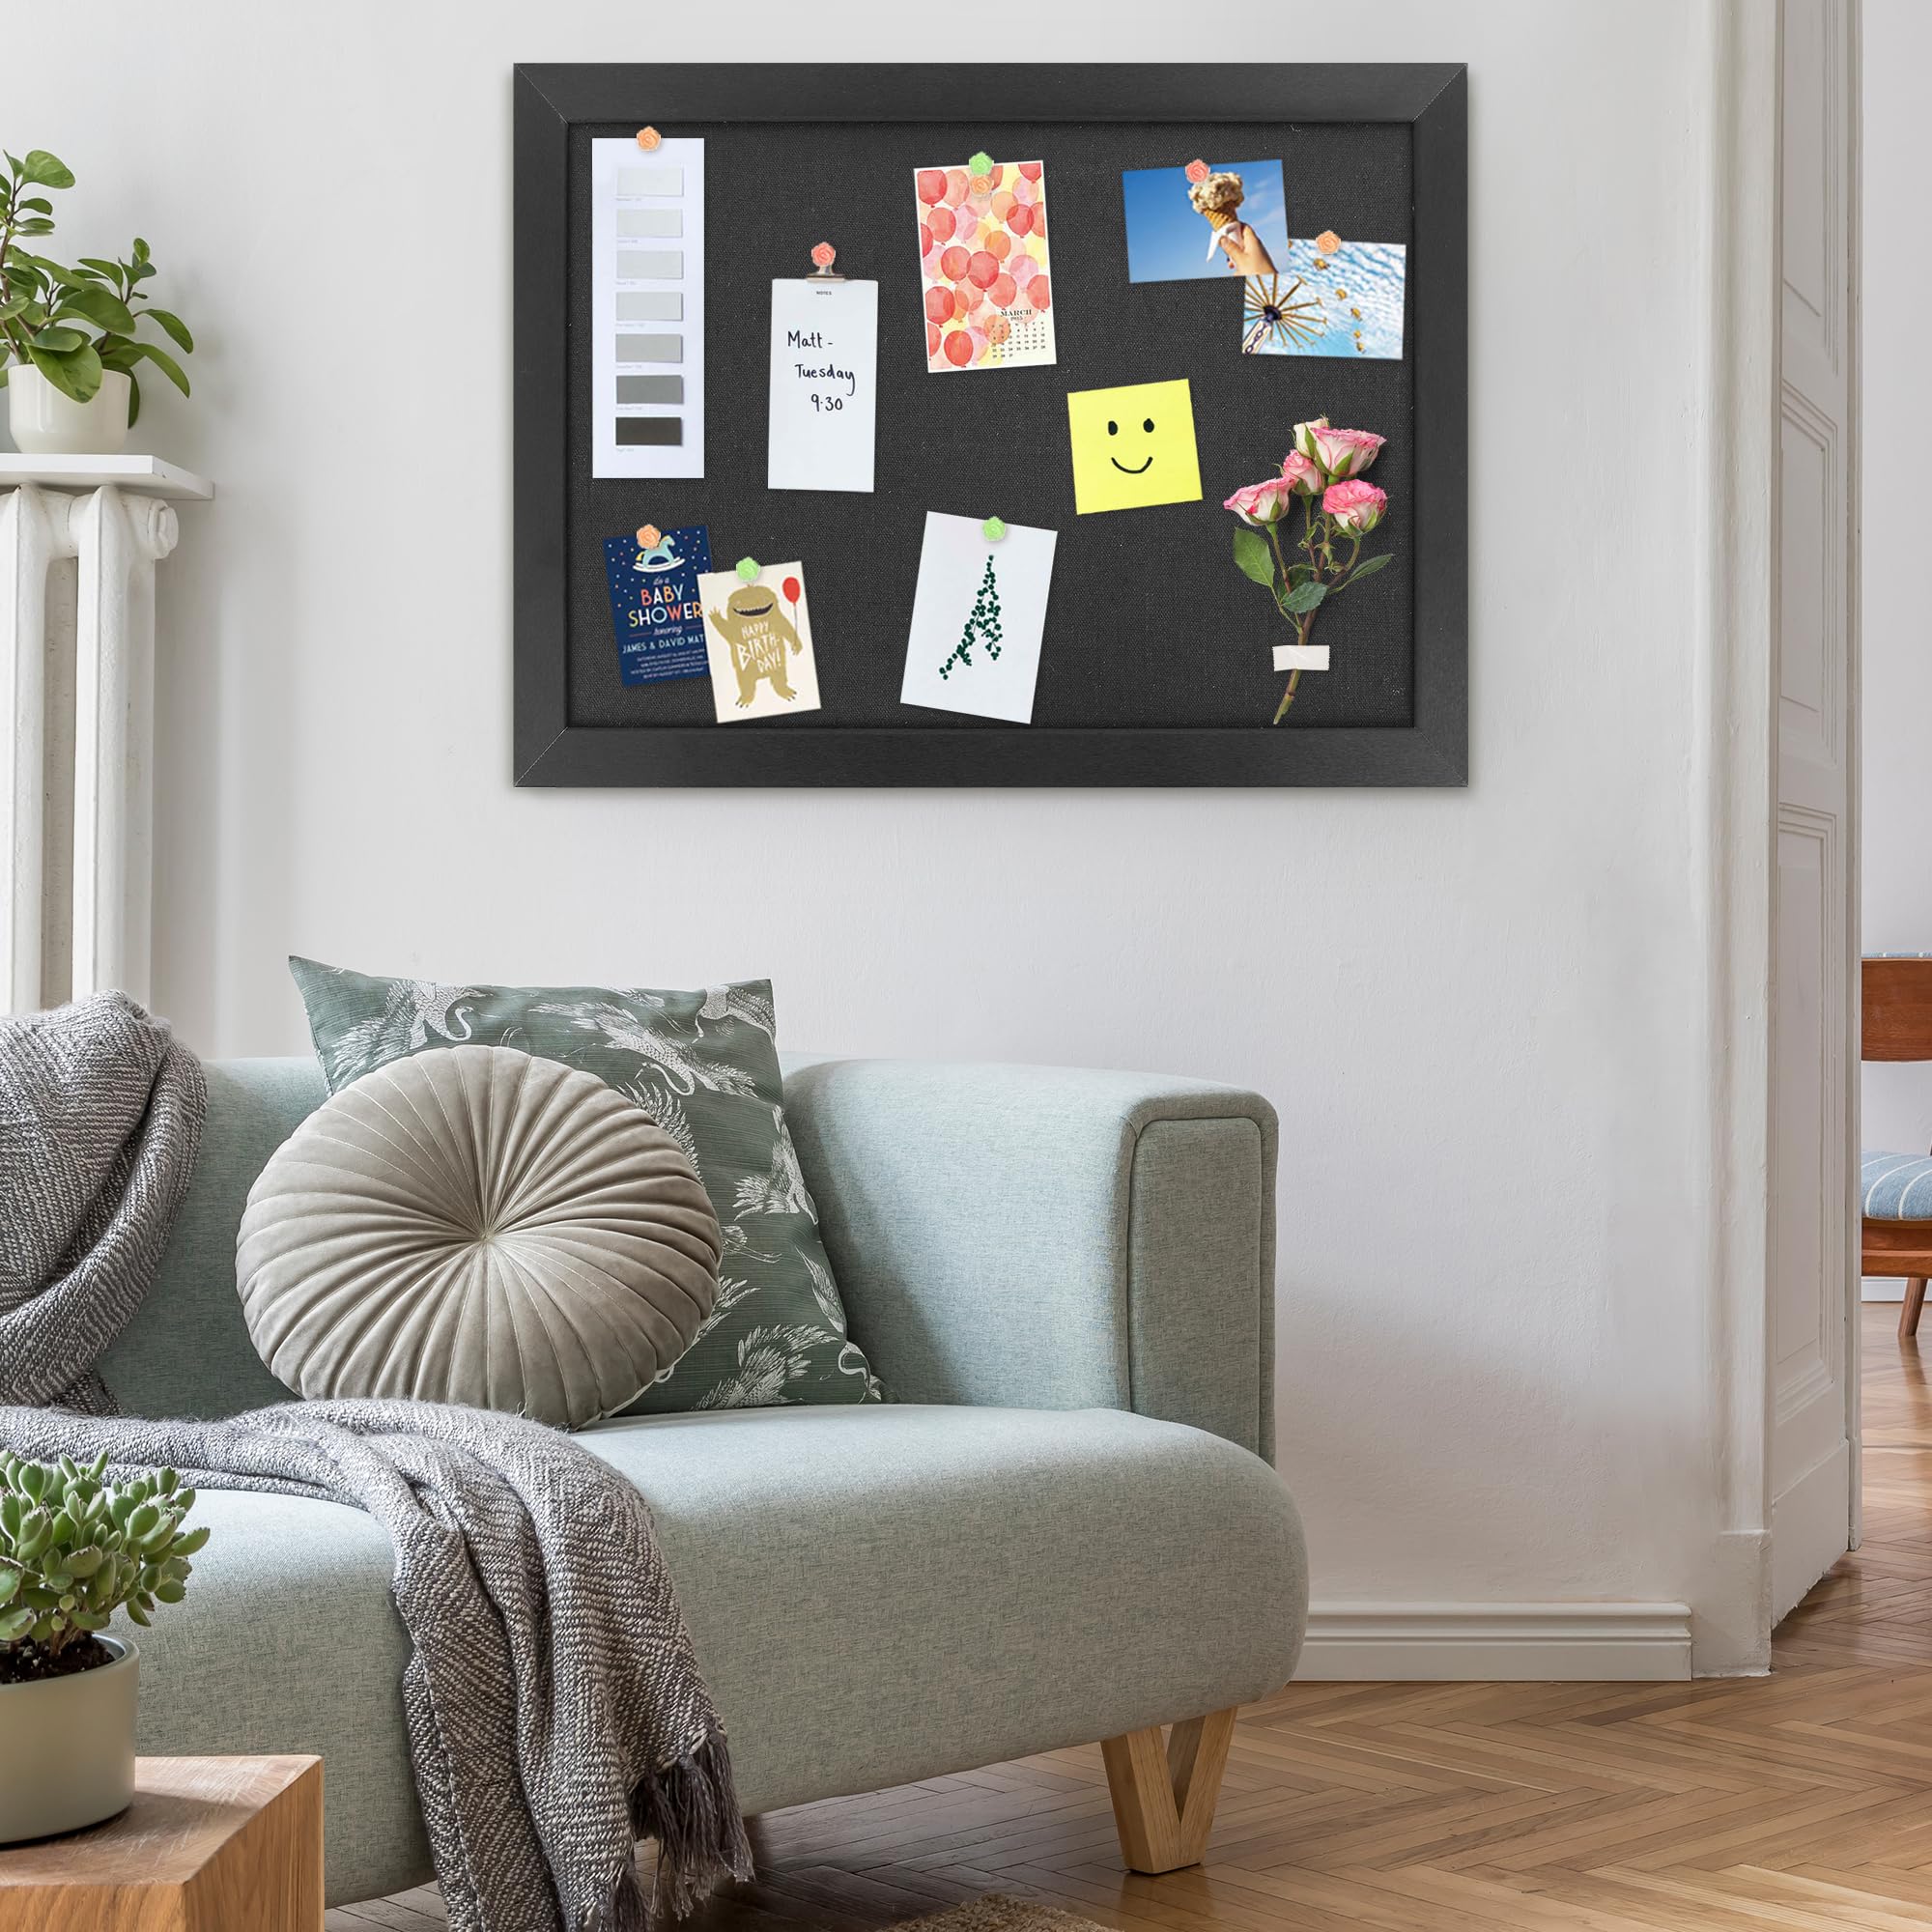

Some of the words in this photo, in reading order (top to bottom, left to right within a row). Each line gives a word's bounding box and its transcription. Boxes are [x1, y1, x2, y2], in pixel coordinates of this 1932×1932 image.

[787, 329, 823, 349] Matt
[794, 364, 856, 397] Tuesday
[640, 583, 684, 607] BABY
[628, 601, 703, 628] SHOWER
[741, 621, 770, 639] HAPPY
[622, 641, 647, 654] JAMES
[649, 641, 656, 650] &
[658, 637, 686, 649] DAVID
[756, 647, 781, 673] DAY!
